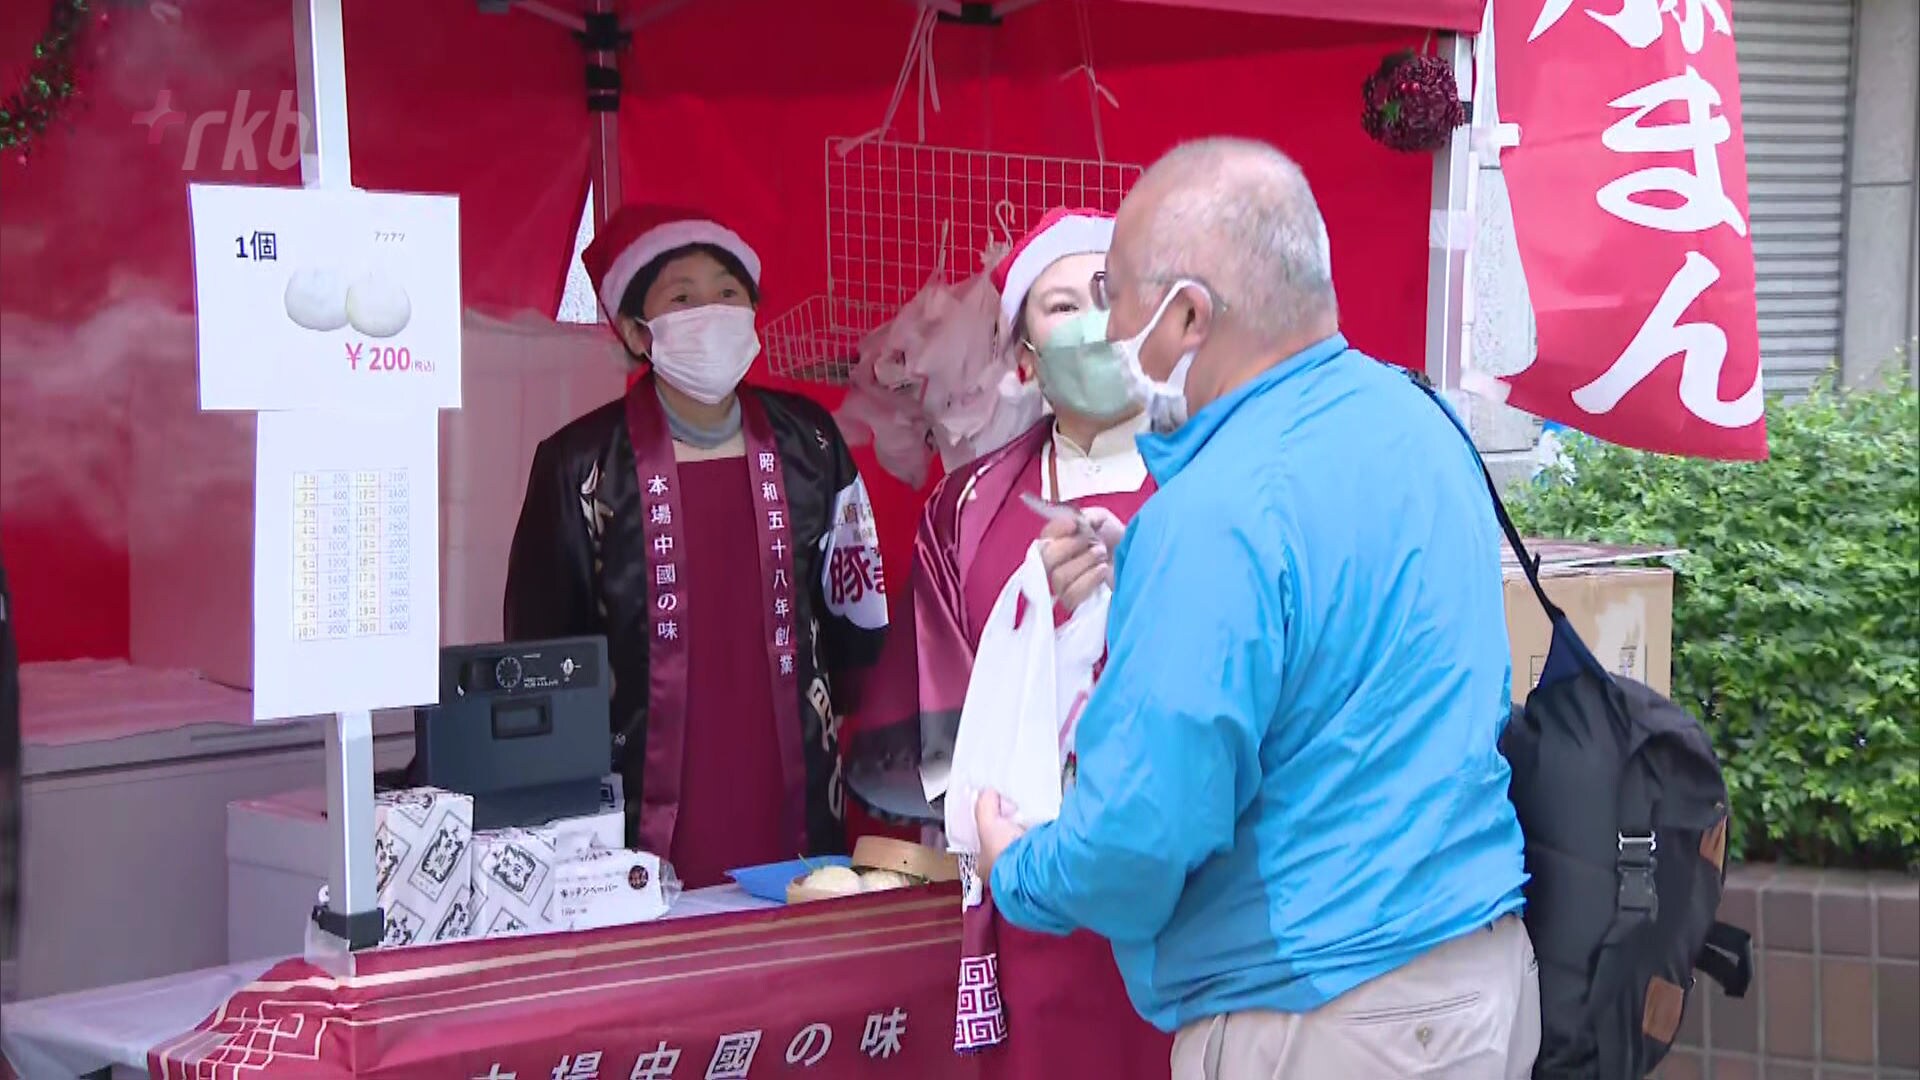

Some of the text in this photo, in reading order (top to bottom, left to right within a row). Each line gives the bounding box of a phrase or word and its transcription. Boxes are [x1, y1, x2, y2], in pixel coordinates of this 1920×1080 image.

[235, 230, 277, 261] 1個
[647, 475, 679, 641] 本場中國の味
[758, 452, 795, 675] 昭和五十八年創業
[472, 1006, 907, 1080] 場中國の味
